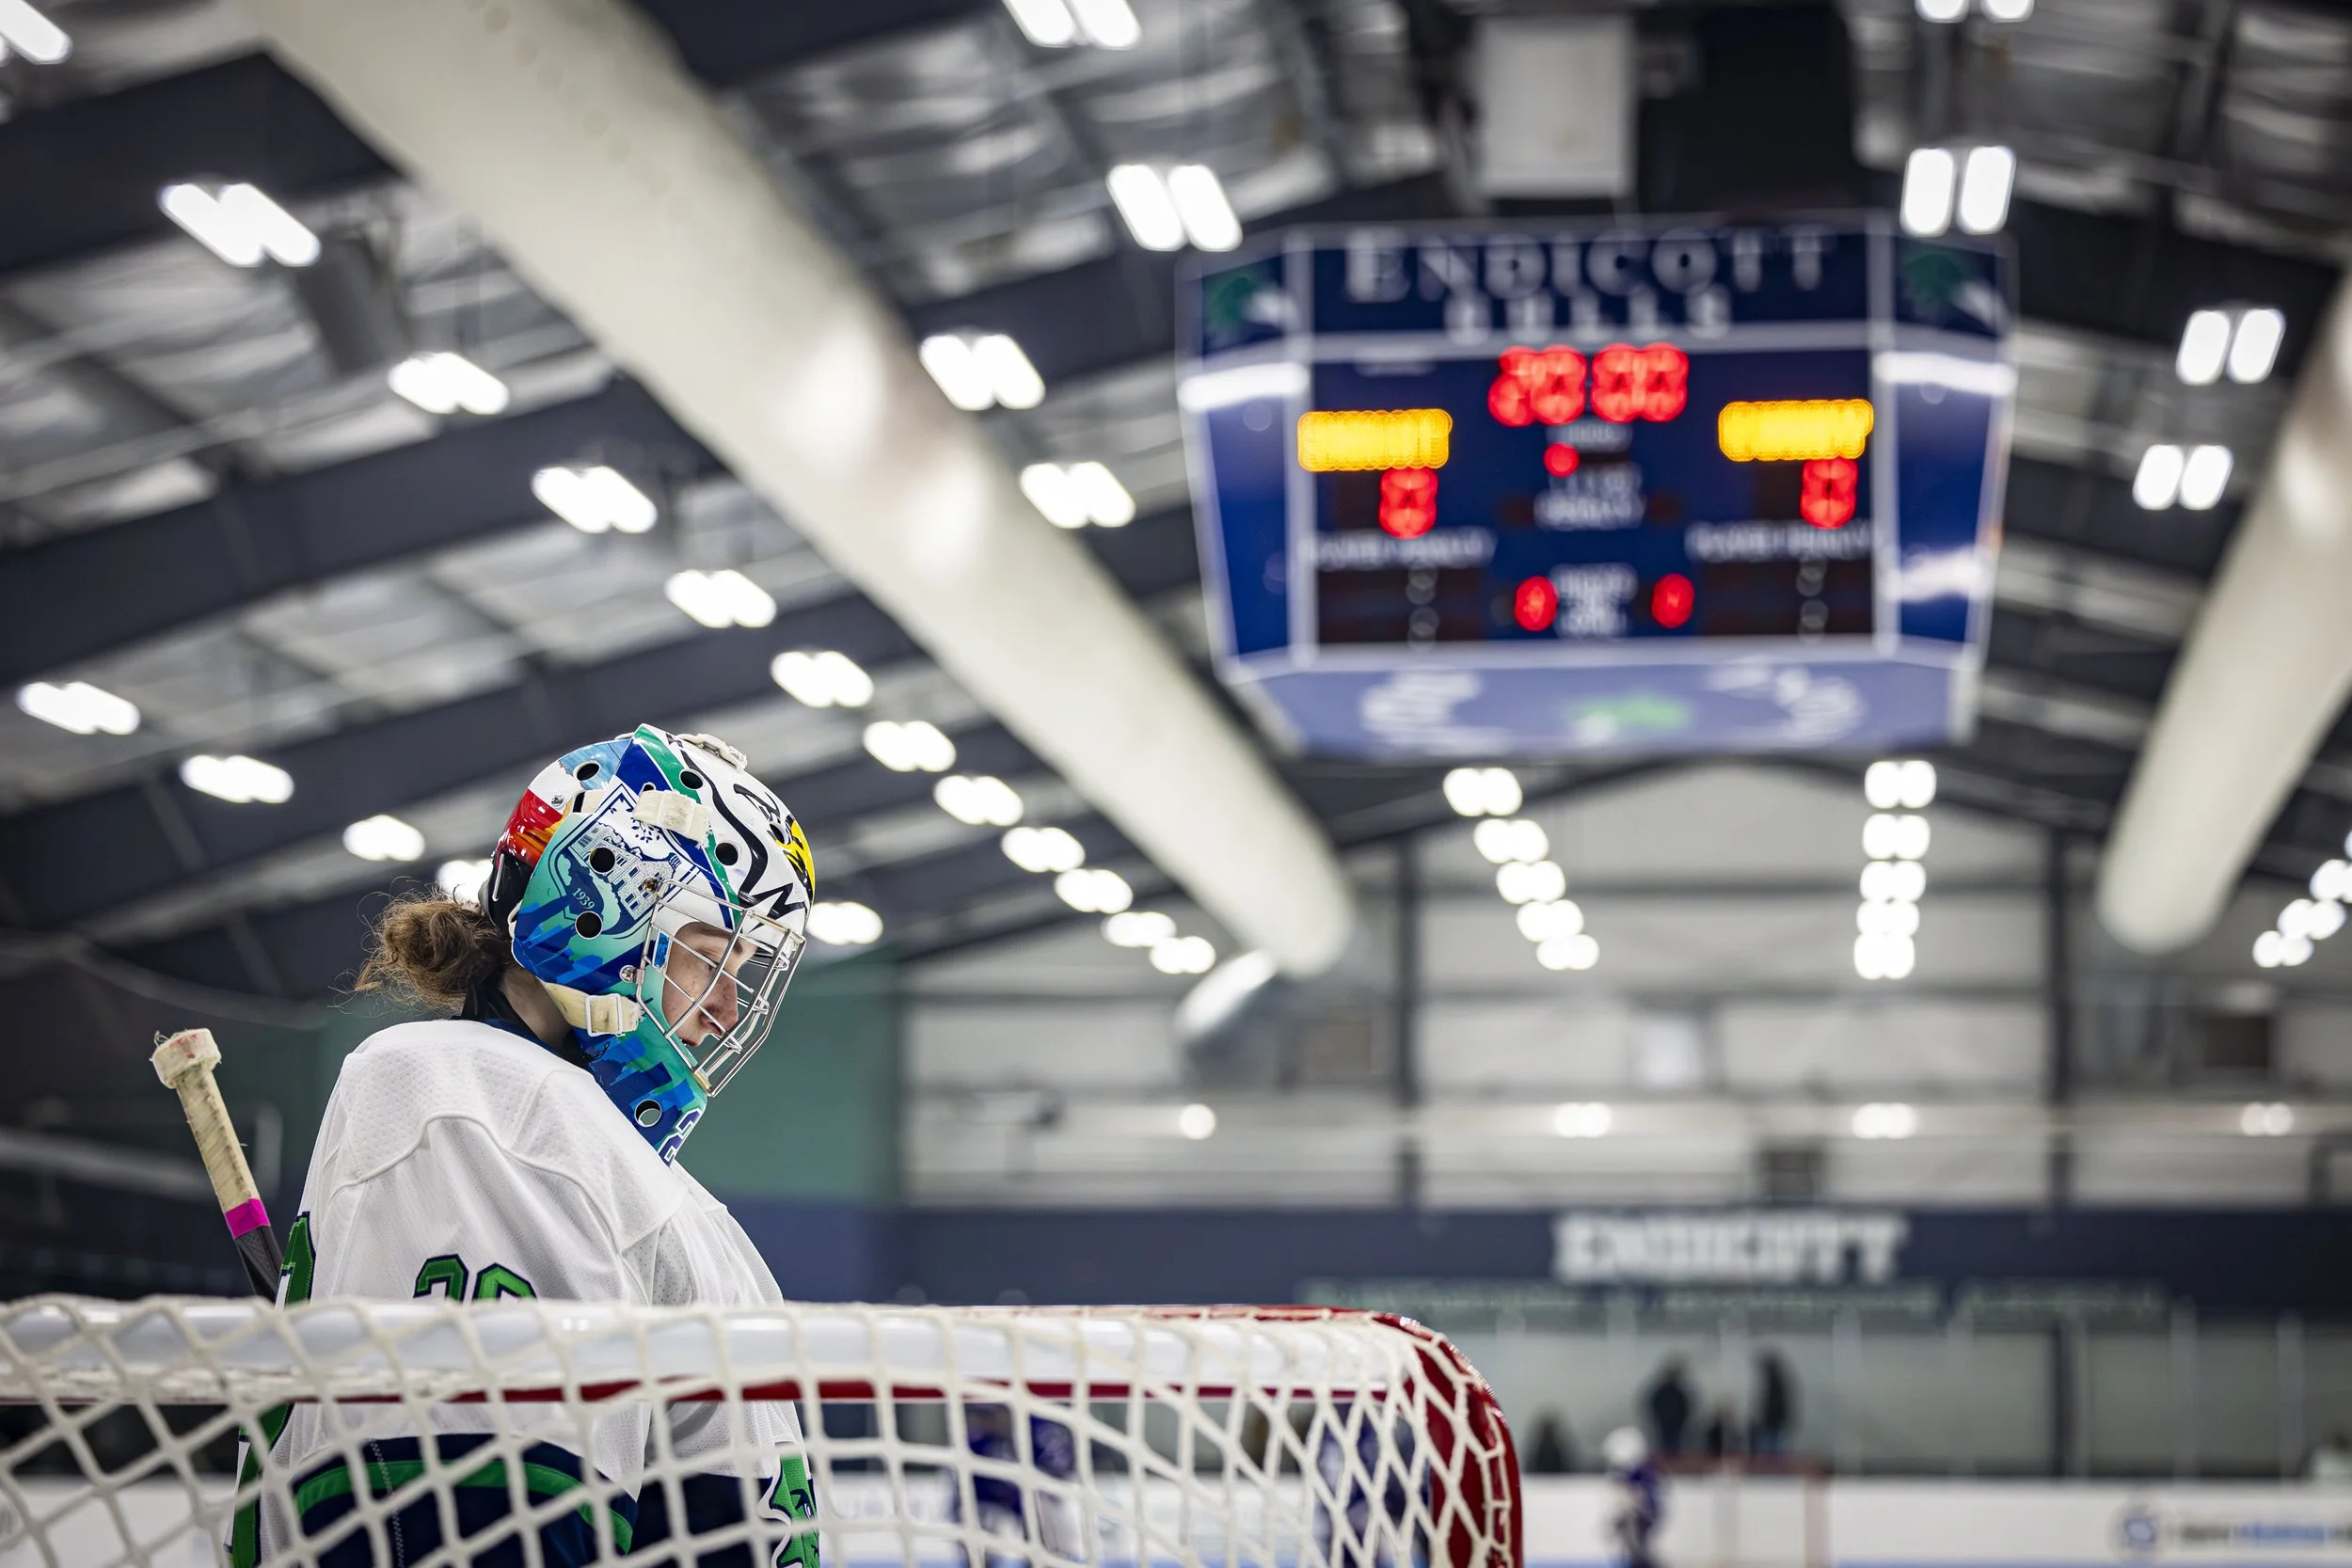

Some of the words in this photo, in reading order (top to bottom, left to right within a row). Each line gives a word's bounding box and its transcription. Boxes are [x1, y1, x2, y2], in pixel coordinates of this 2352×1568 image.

[1345, 227, 1830, 302] ENDICOTT
[572, 887, 596, 910] 1939
[1555, 1210, 1908, 1283] ENDICOTT
